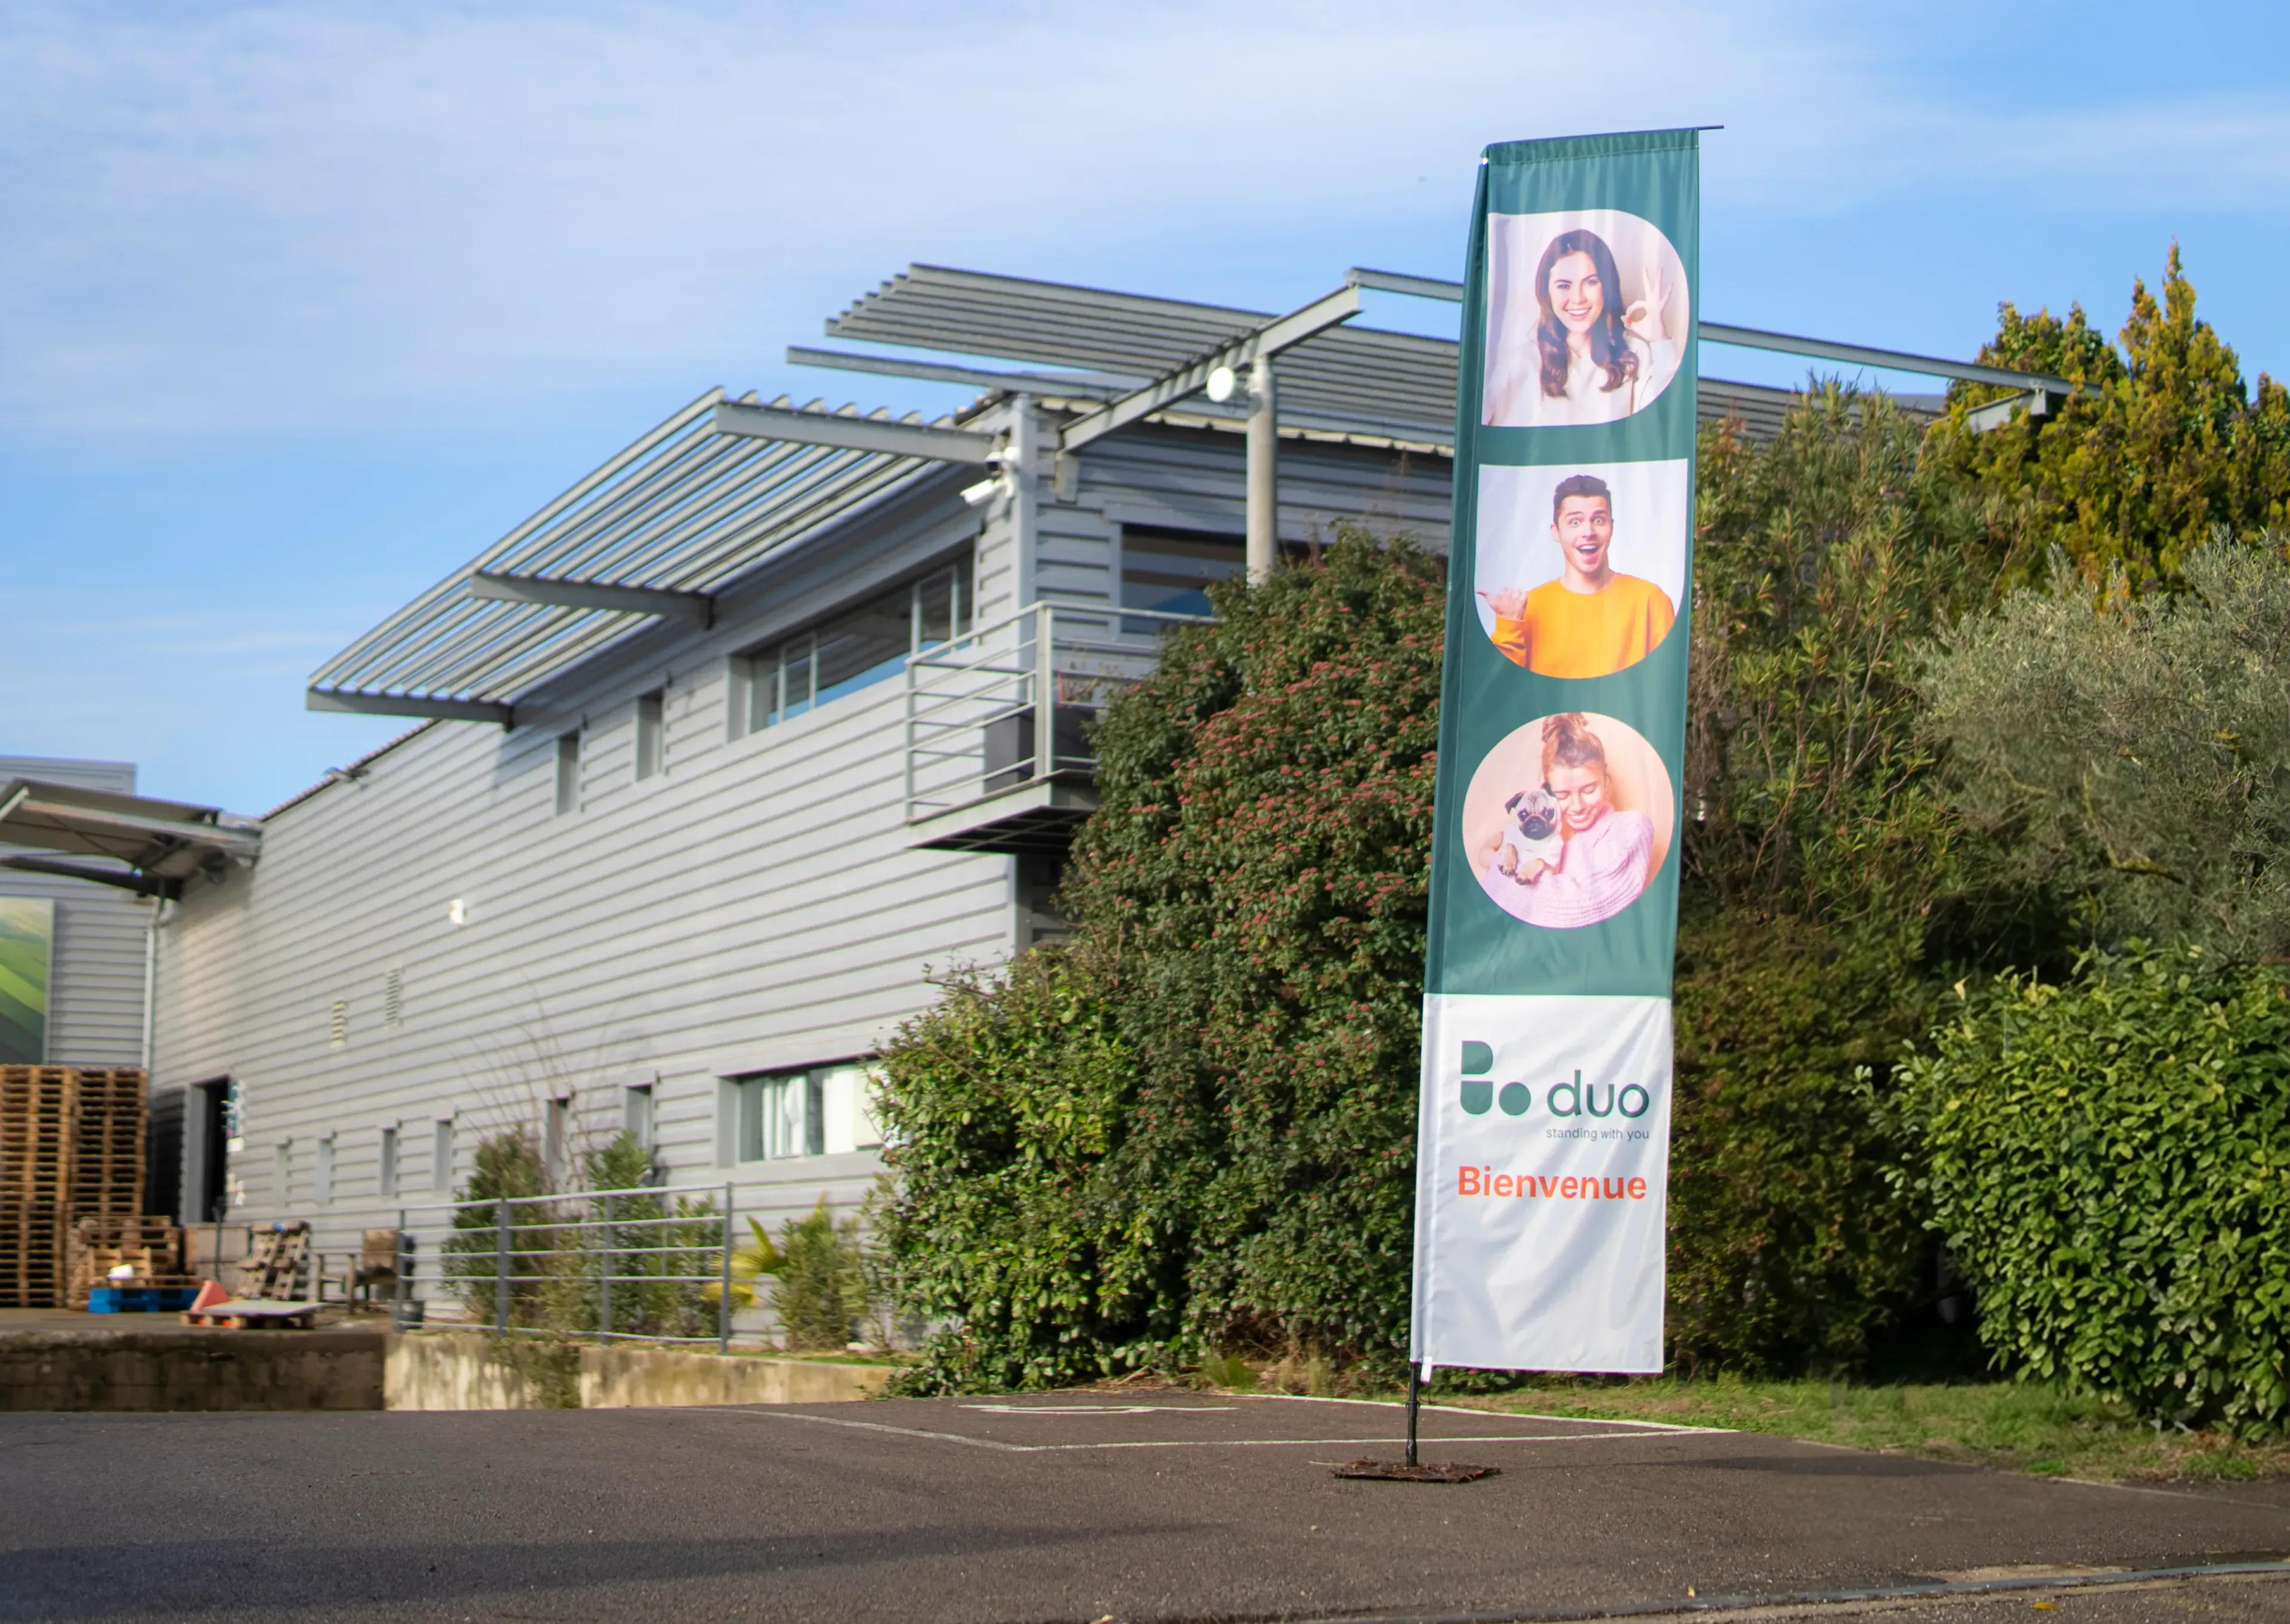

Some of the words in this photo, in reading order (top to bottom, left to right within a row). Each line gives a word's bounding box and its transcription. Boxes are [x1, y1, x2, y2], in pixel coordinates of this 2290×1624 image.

[1547, 1069, 1650, 1118] duo
[1546, 1128, 1597, 1142] standing
[1601, 1128, 1623, 1139] with
[1627, 1130, 1650, 1142] you
[1458, 1165, 1647, 1199] Bienvenue
